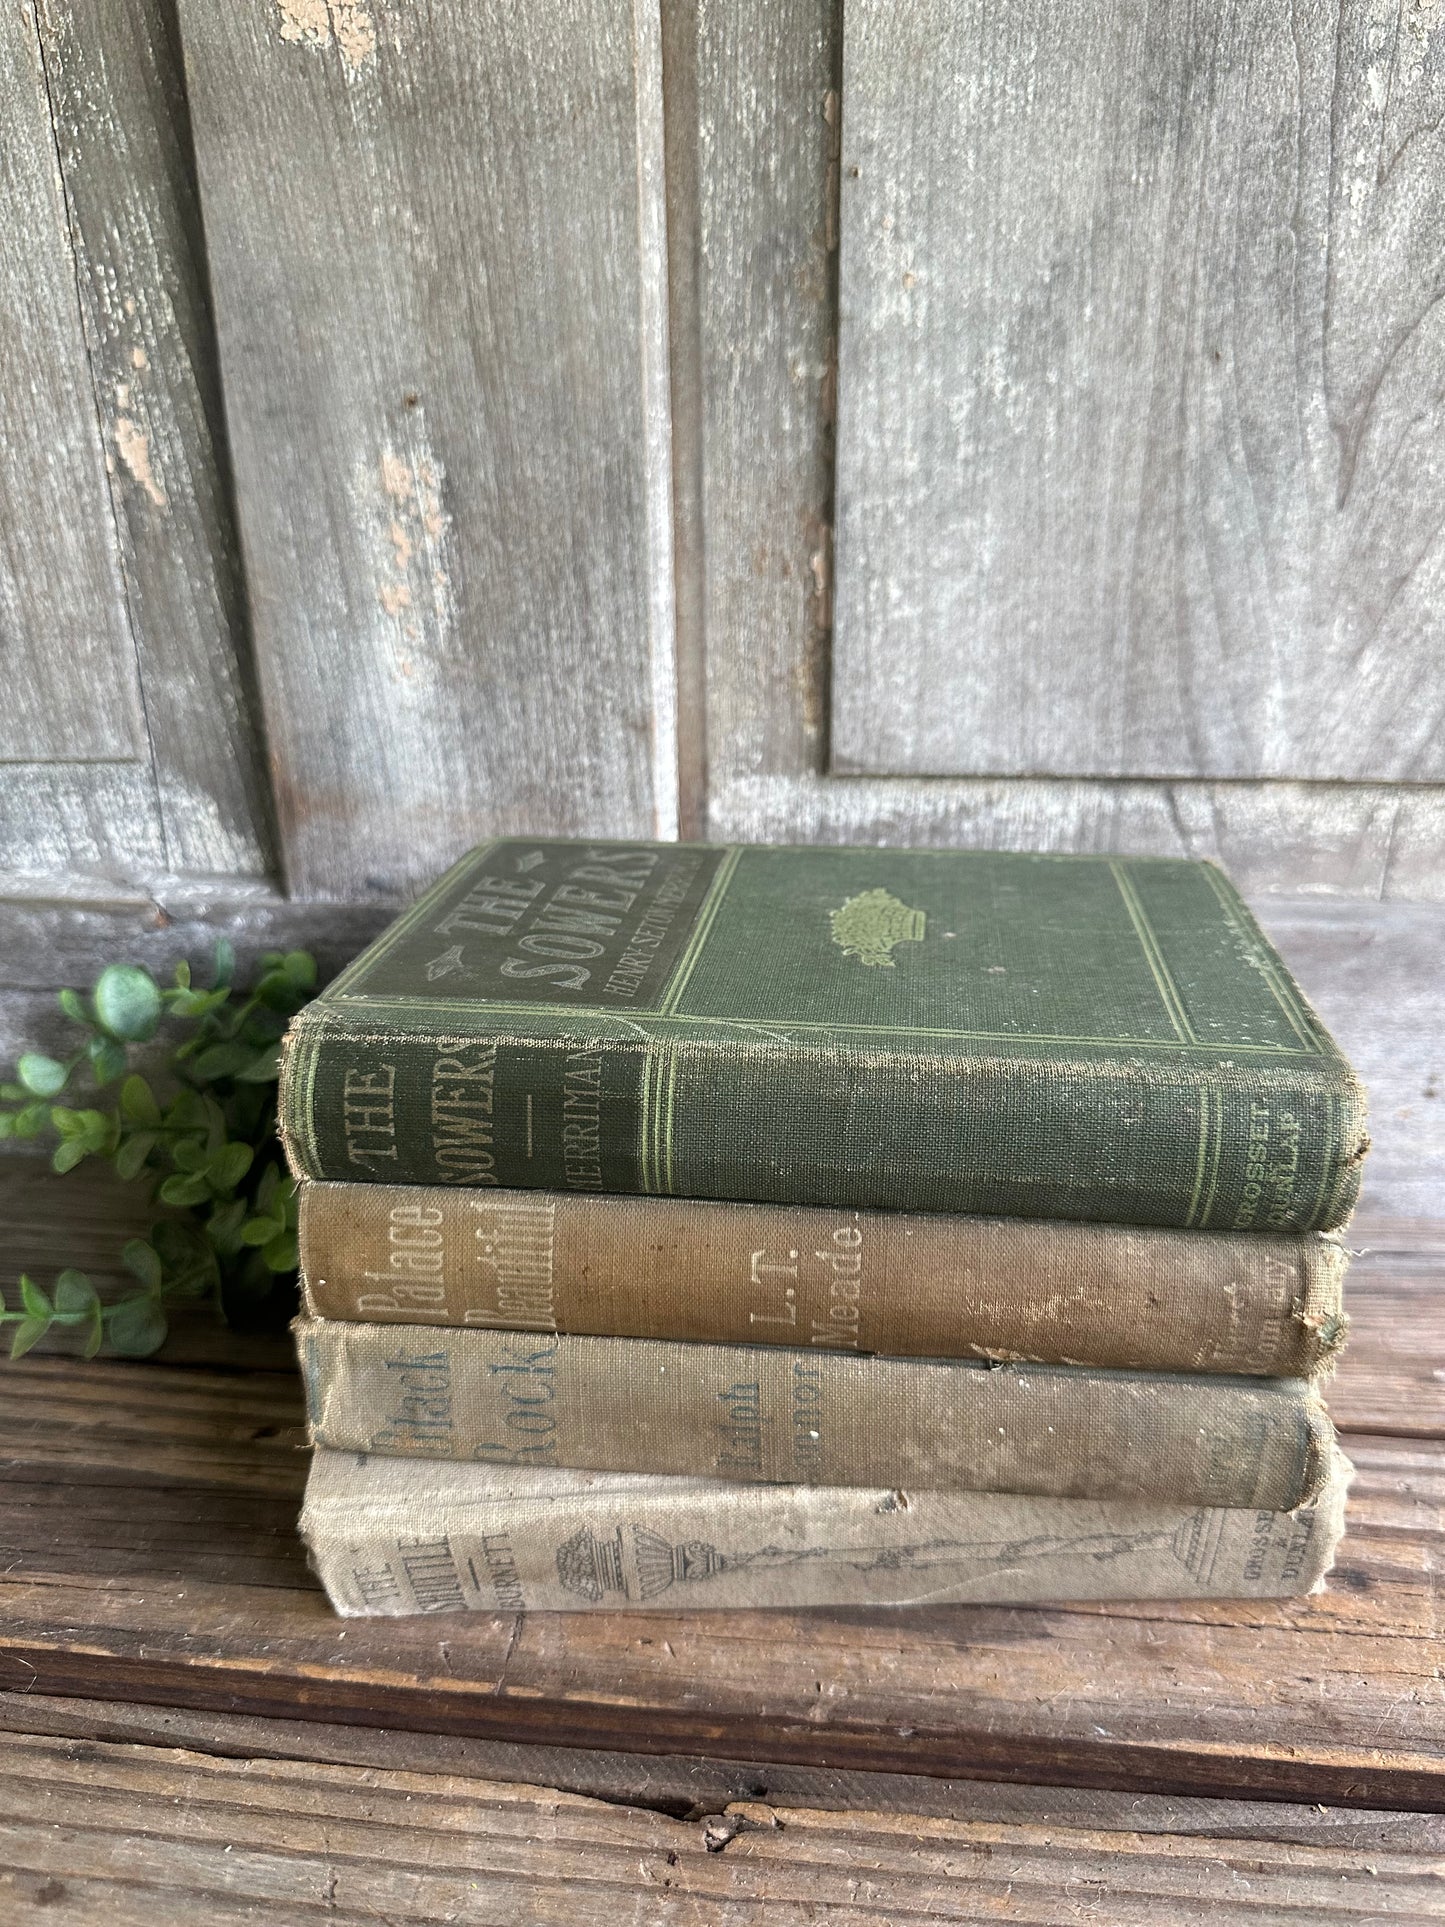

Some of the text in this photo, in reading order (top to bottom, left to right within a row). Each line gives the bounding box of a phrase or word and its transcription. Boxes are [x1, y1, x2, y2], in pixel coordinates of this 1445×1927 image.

[434, 873, 546, 936] THE
[501, 848, 658, 991] SOWERS
[602, 945, 655, 997] HENRY
[631, 906, 677, 948] SETON
[343, 1063, 399, 1166] THE
[431, 1041, 498, 1184] SOWERS
[1232, 1103, 1270, 1228] GROSSET
[358, 1205, 449, 1316] Palace
[464, 1201, 556, 1328] Beautiful
[811, 1227, 863, 1347] Meade
[371, 1348, 452, 1454] Black
[474, 1346, 556, 1465] Rock
[716, 1382, 772, 1470] Ralph
[352, 1561, 400, 1605] THE
[397, 1534, 469, 1611] SHUTTLE
[481, 1530, 526, 1609] BURNETT
[1243, 1509, 1275, 1581] GROSSE
